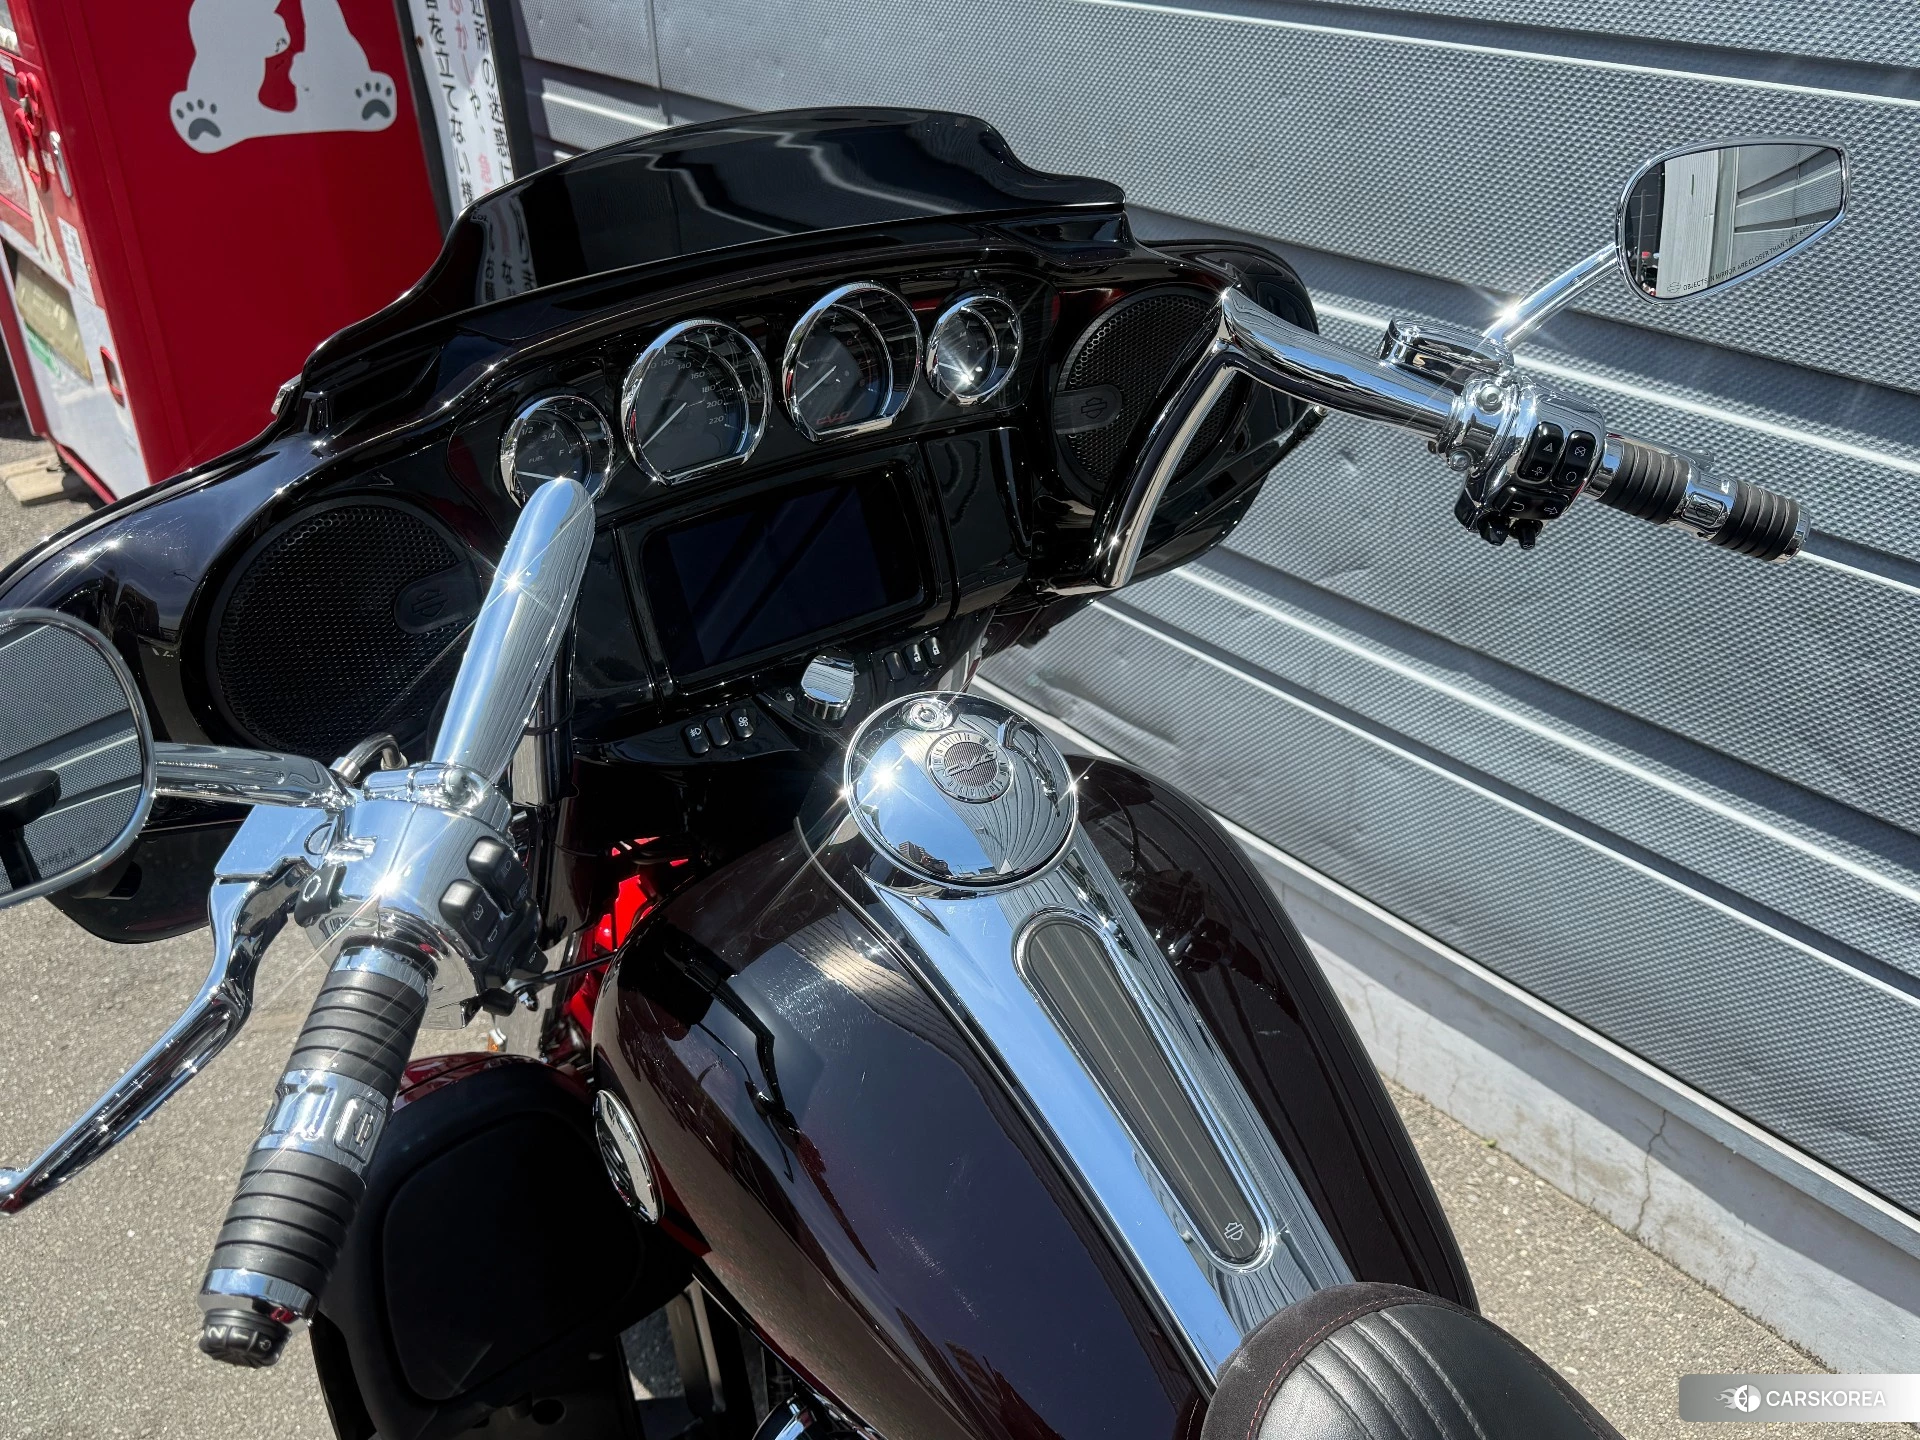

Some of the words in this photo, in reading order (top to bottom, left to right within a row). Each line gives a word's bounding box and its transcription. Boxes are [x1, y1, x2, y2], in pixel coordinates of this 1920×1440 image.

[1683, 277, 1708, 291] OBJECTS
[1715, 267, 1737, 280] MIRROR
[1737, 260, 1749, 270] ARE
[1748, 250, 1770, 266] CLOSER
[1769, 242, 1785, 254] THAN
[1785, 233, 1798, 244] THEY
[661, 358, 675, 367] 120
[677, 361, 692, 371] 140
[691, 371, 706, 380] 160
[701, 384, 716, 393] 180
[706, 399, 723, 409] 200
[708, 415, 725, 425] 220
[521, 426, 534, 436] 1/2
[541, 432, 556, 442] 3/4
[558, 449, 565, 457] F
